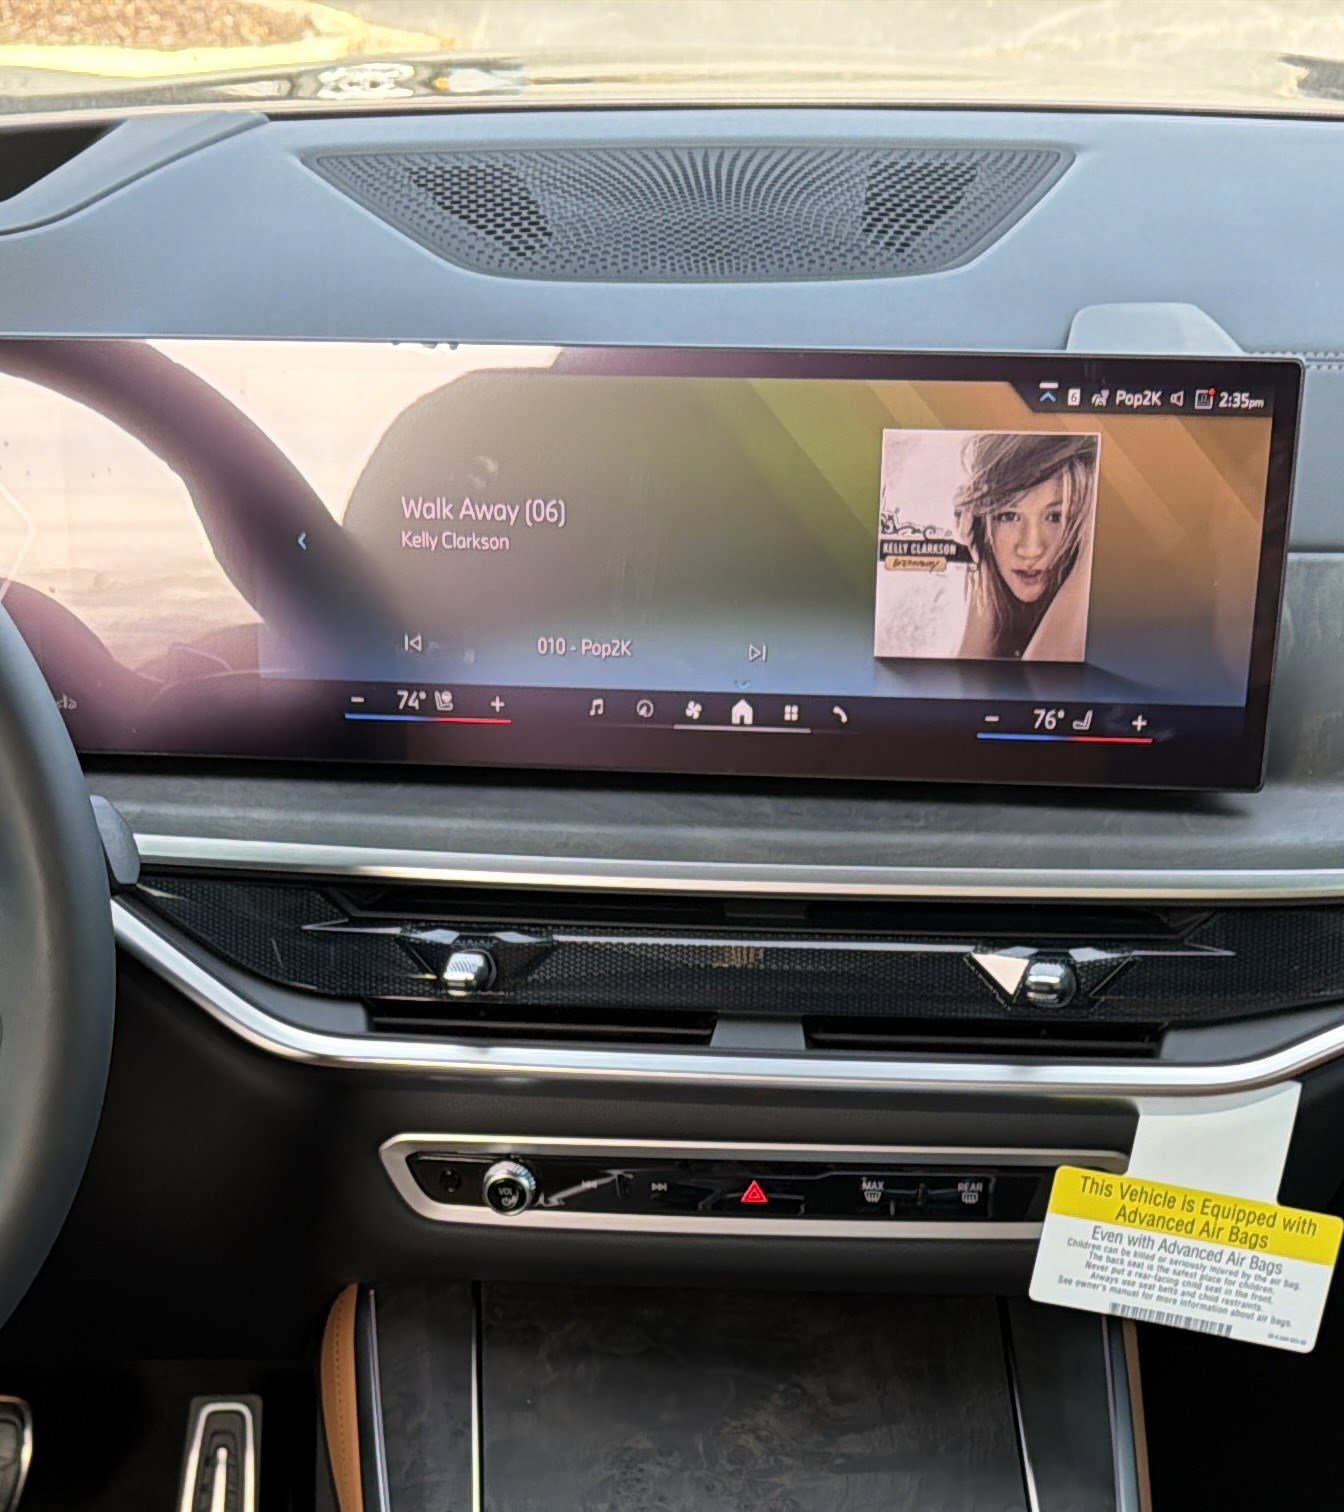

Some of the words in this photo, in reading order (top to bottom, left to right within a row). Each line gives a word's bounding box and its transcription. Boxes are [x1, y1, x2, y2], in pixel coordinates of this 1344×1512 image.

[1116, 390, 1162, 409] Pop2K
[401, 496, 454, 520] Walk
[459, 497, 520, 526] Away
[525, 498, 566, 527] (06)
[401, 531, 438, 551] Kelly
[442, 531, 510, 550] Clarkson
[882, 542, 908, 555] KELLY
[910, 543, 957, 556] CLARKSON
[537, 637, 566, 656] 010
[581, 638, 632, 660] Pop2K
[1080, 1175, 1114, 1198] This
[1119, 1182, 1177, 1210] Vehicle
[1181, 1194, 1195, 1213] is
[1200, 1198, 1278, 1228] Equipped
[1282, 1214, 1318, 1237] with
[1115, 1204, 1196, 1235] Advanced
[1199, 1220, 1225, 1240] Air
[1228, 1225, 1270, 1250] Bags
[1066, 1237, 1102, 1251] Children
[1104, 1245, 1119, 1254] can
[1120, 1246, 1131, 1257] be
[1132, 1249, 1156, 1262] killed
[1157, 1255, 1167, 1264] or
[1169, 1257, 1207, 1273] seriously
[1209, 1265, 1240, 1279] injured
[1241, 1270, 1251, 1281] by
[1254, 1274, 1267, 1283] the
[1269, 1277, 1282, 1287] air
[1091, 1225, 1124, 1244] Even
[1127, 1232, 1155, 1251] with
[1158, 1238, 1224, 1263] Advanced
[1226, 1250, 1247, 1268] Air
[1249, 1255, 1283, 1276] Bags
[1084, 1261, 1109, 1273] Never
[1110, 1265, 1125, 1276] put
[1134, 1270, 1180, 1286] rear-facing
[1181, 1276, 1203, 1289] child
[1205, 1283, 1222, 1293] seat
[1235, 1289, 1249, 1299] the
[1089, 1251, 1104, 1262] The
[1105, 1255, 1125, 1266] back
[1127, 1259, 1144, 1269] seat
[1156, 1264, 1170, 1275] the
[1172, 1267, 1197, 1279] safest
[1199, 1272, 1222, 1284] place
[1224, 1277, 1237, 1287] for
[1057, 1274, 1073, 1286] See
[1108, 1286, 1140, 1298] manual
[1141, 1291, 1154, 1301] for
[1155, 1294, 1178, 1305] more
[1230, 1309, 1256, 1321] about
[1090, 1272, 1119, 1285] Always
[1121, 1278, 1136, 1288] use
[1138, 1281, 1156, 1291] seat
[1180, 1289, 1197, 1299] and
[1198, 1292, 1219, 1303] child
